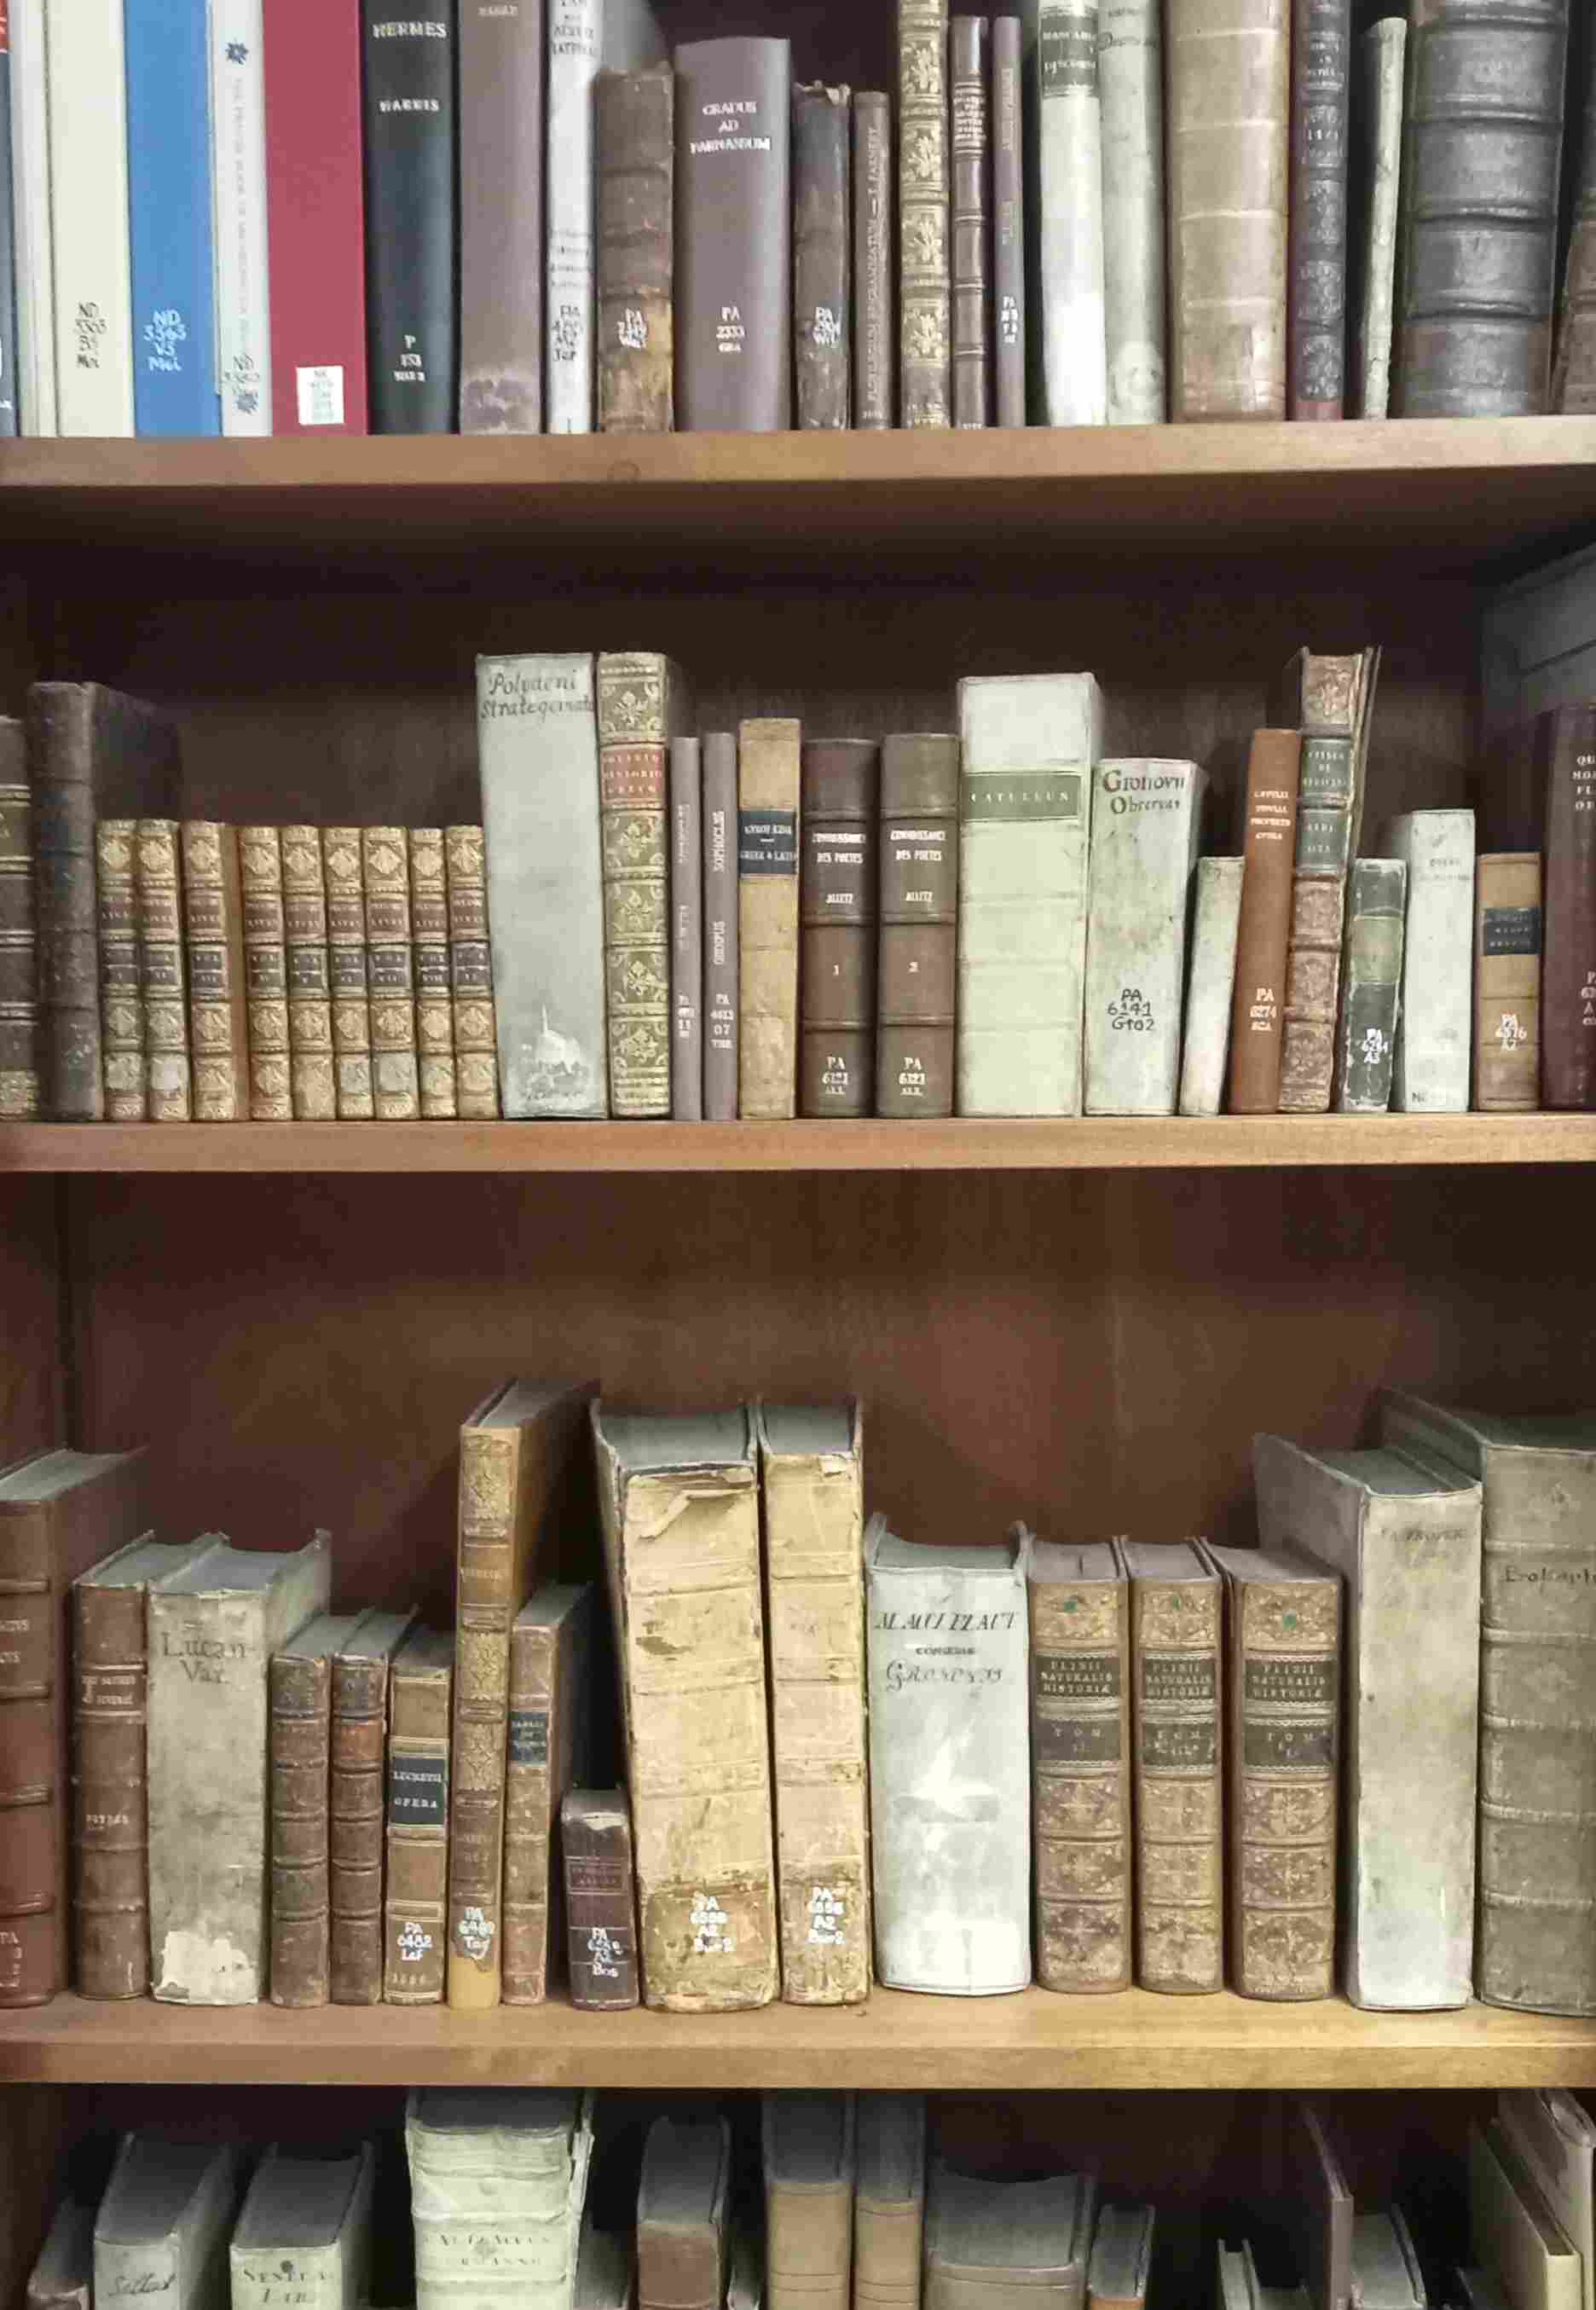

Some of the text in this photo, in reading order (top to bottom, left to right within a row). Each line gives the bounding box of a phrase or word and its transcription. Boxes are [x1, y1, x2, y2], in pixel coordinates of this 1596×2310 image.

[373, 22, 447, 38] HERMES
[379, 100, 440, 112] HARRIS
[719, 119, 740, 133] AD
[721, 306, 741, 321] PA
[1121, 989, 1142, 1002] PA
[1256, 987, 1275, 1001] PA
[826, 1057, 846, 1069] PA
[904, 1057, 922, 1070] PA
[394, 1798, 437, 1809] OPERA
[404, 1923, 424, 1936] PA
